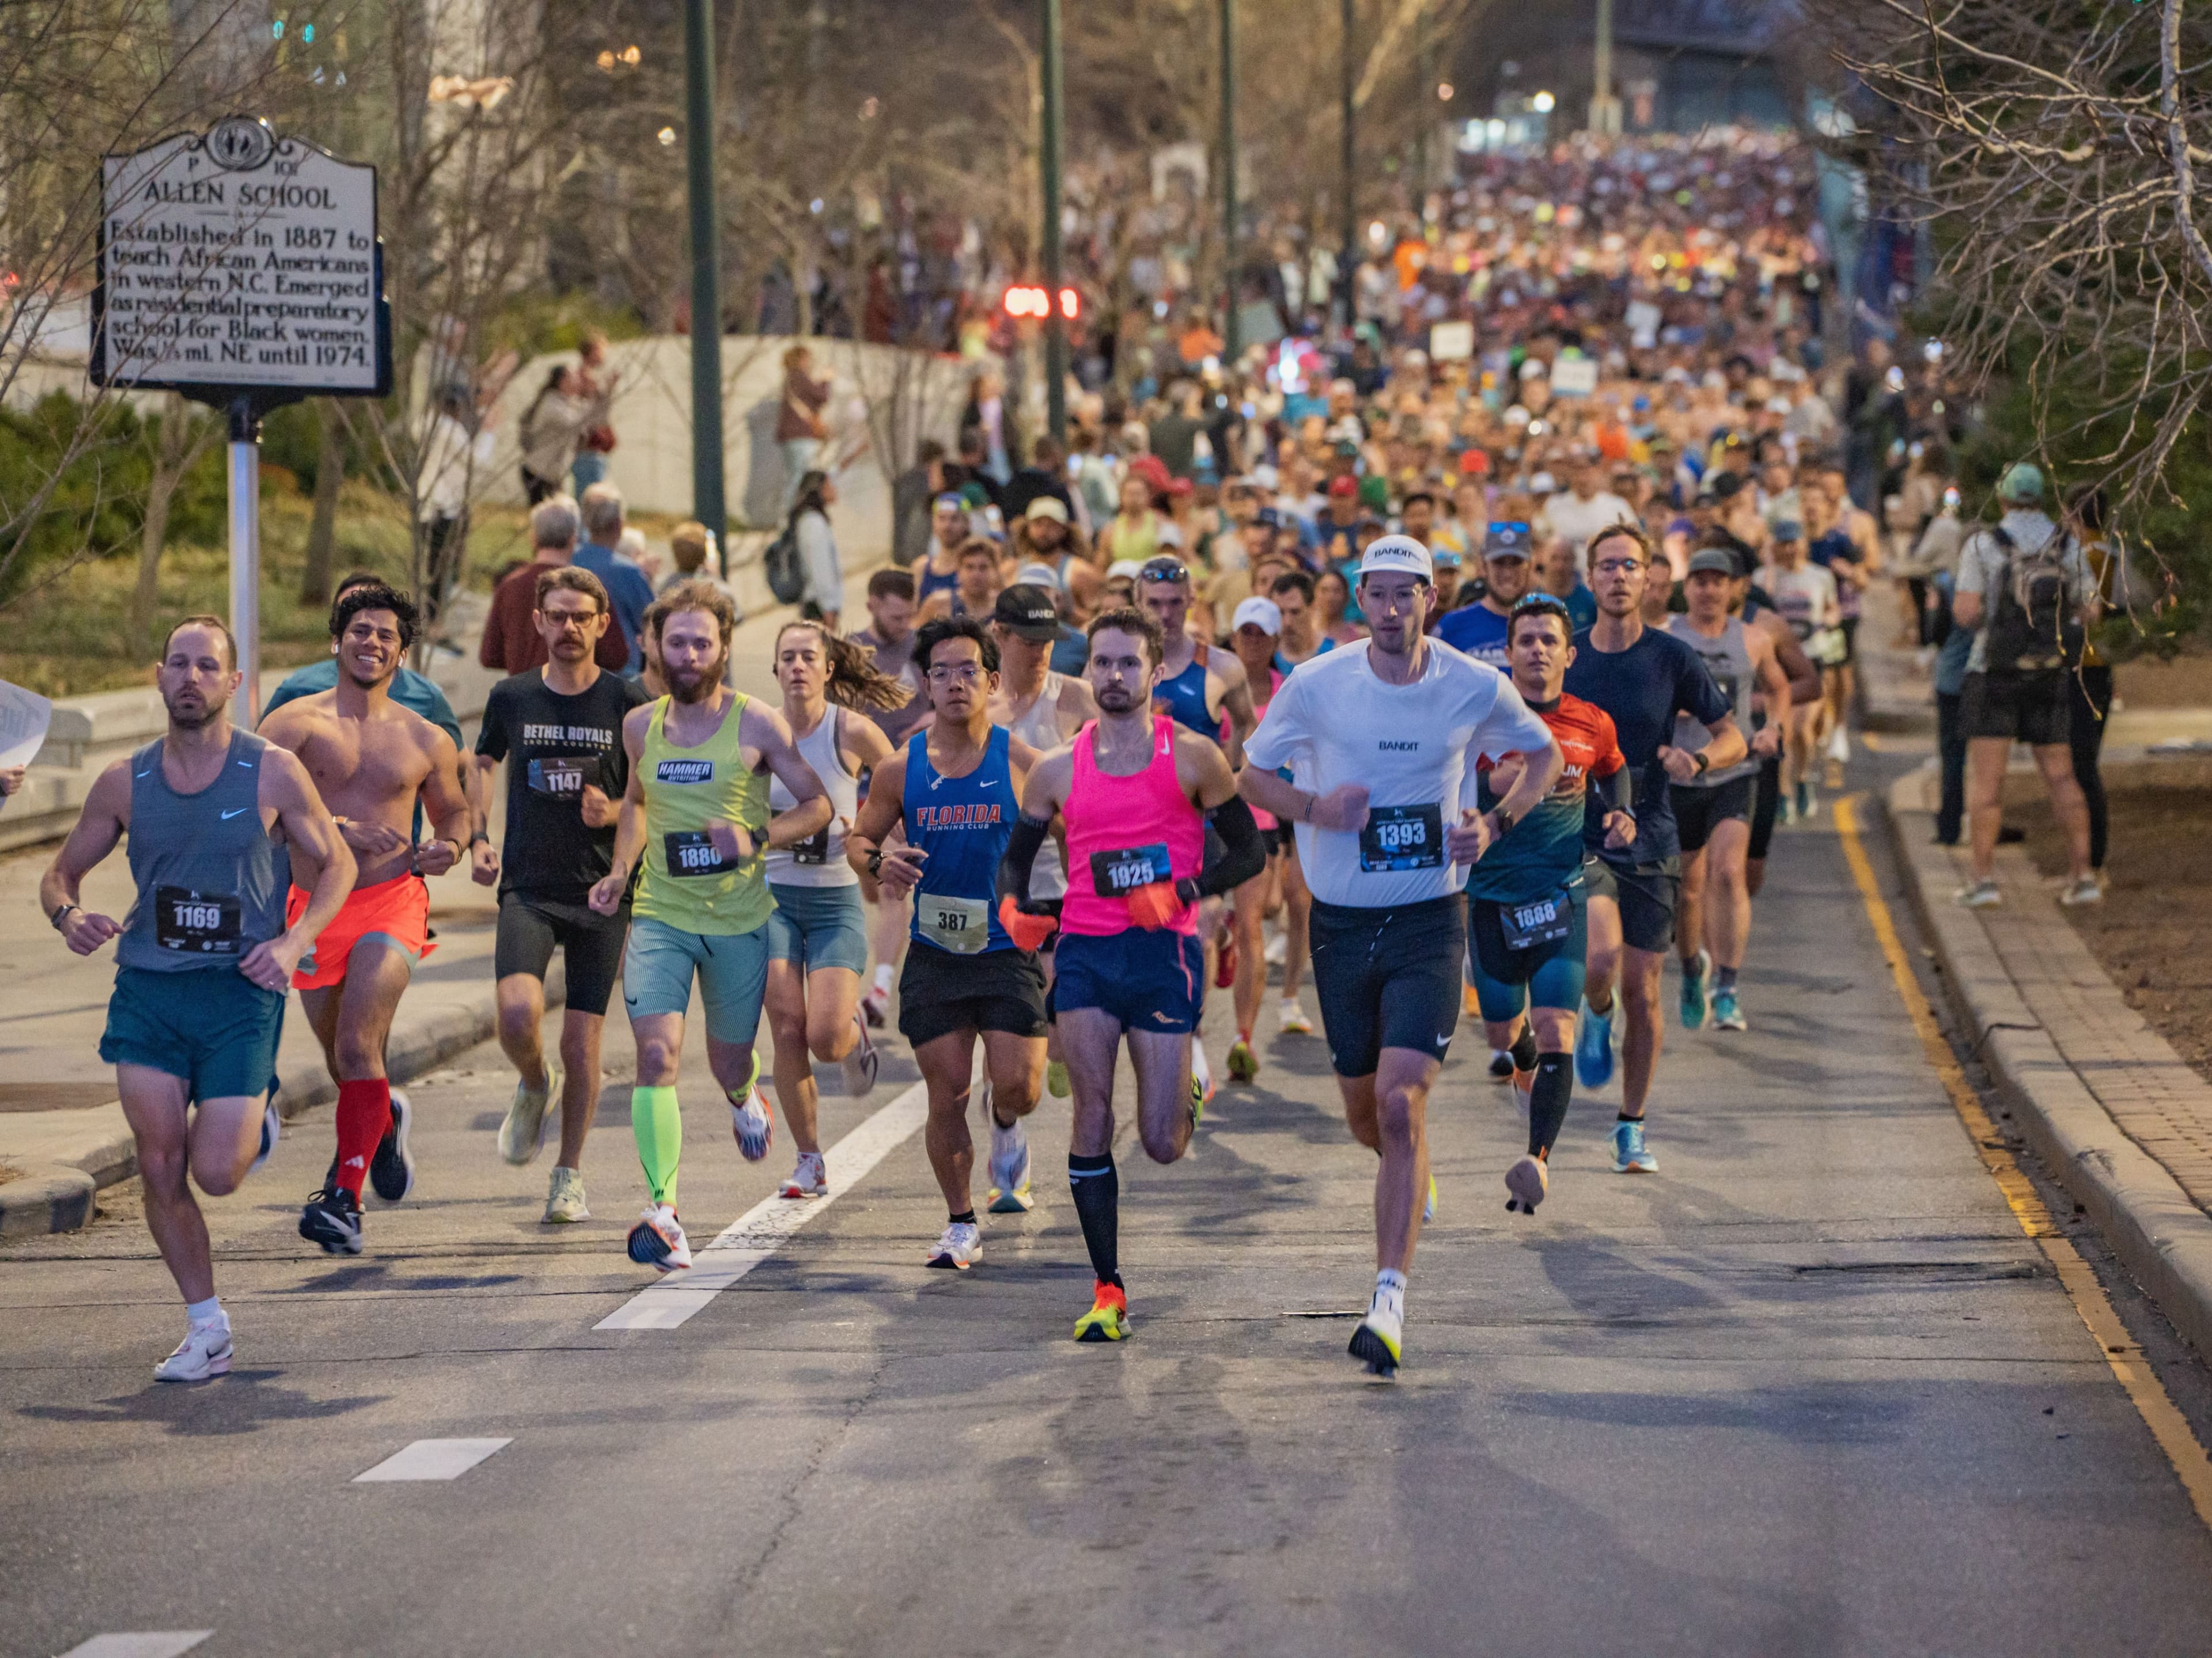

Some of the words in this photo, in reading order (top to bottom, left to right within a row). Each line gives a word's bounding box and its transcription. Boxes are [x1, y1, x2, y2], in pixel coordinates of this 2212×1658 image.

[145, 180, 224, 204] ALLEN
[238, 182, 337, 210] SCHOOL
[111, 220, 243, 246] Established
[254, 229, 272, 246] in
[285, 226, 336, 249] 1887
[349, 230, 369, 251] to
[112, 245, 170, 267] teach
[178, 246, 256, 268] African
[264, 251, 369, 273] Americans
[111, 270, 130, 287] in
[137, 272, 221, 291] western
[275, 274, 369, 299] Emerged
[111, 297, 133, 312] as
[244, 301, 369, 326] preparatory
[112, 316, 180, 338] school
[189, 317, 221, 338] for
[229, 318, 287, 342] Black
[294, 328, 369, 344] women.
[221, 340, 253, 364] NE
[260, 344, 306, 365] until
[317, 345, 370, 367] 1974.
[1374, 547, 1412, 559] BANDIT
[523, 723, 565, 740] BETHEL
[567, 726, 613, 745] ROYALS
[562, 741, 612, 751] COUNTRY
[1379, 740, 1419, 752] BANDIT
[658, 762, 711, 776] HAMMER
[547, 772, 582, 792] 1147
[916, 804, 1002, 826] FLORIDA
[926, 824, 964, 832] RUNNING
[1377, 822, 1426, 847] 1393
[1108, 862, 1155, 889] 1925
[173, 905, 221, 930] 1169
[938, 911, 967, 931] 387
[1514, 902, 1556, 929] 1888
